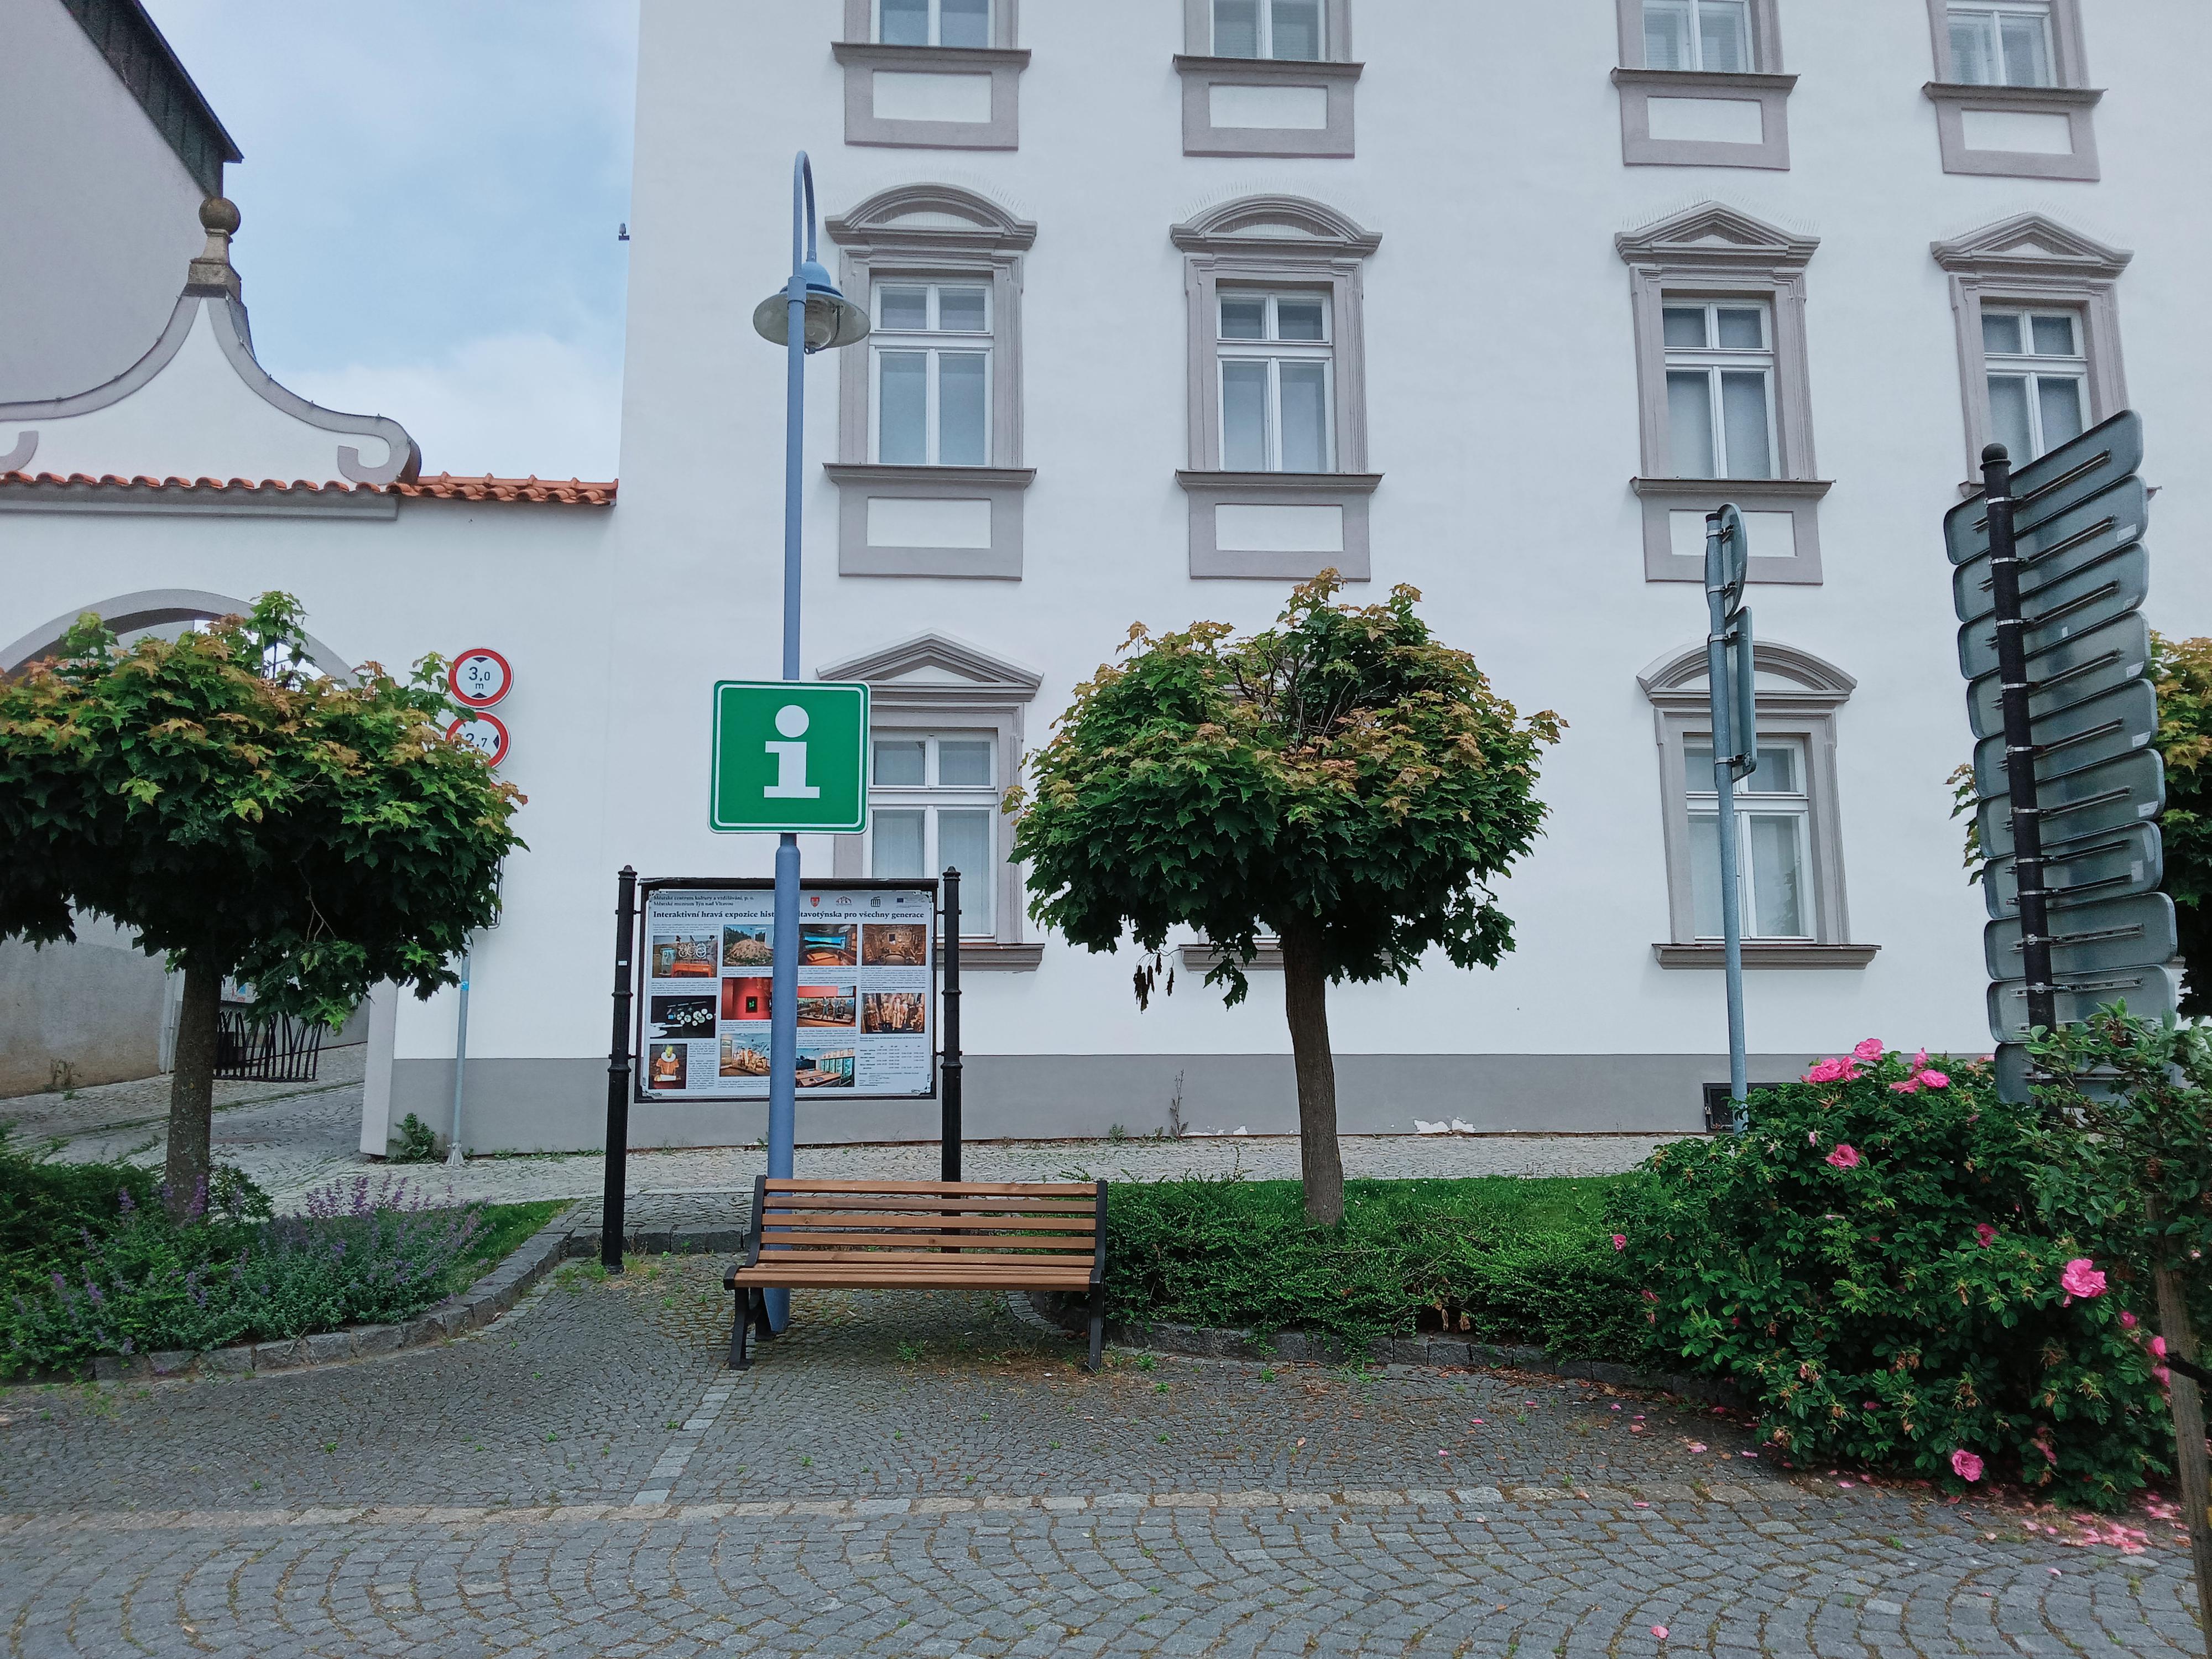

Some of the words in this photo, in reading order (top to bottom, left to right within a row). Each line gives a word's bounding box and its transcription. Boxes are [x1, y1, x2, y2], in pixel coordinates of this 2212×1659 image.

[469, 666, 490, 681] 3,0
[725, 911, 758, 919] expozice
[799, 911, 842, 919] ltavotýnska
[859, 911, 890, 919] všechny
